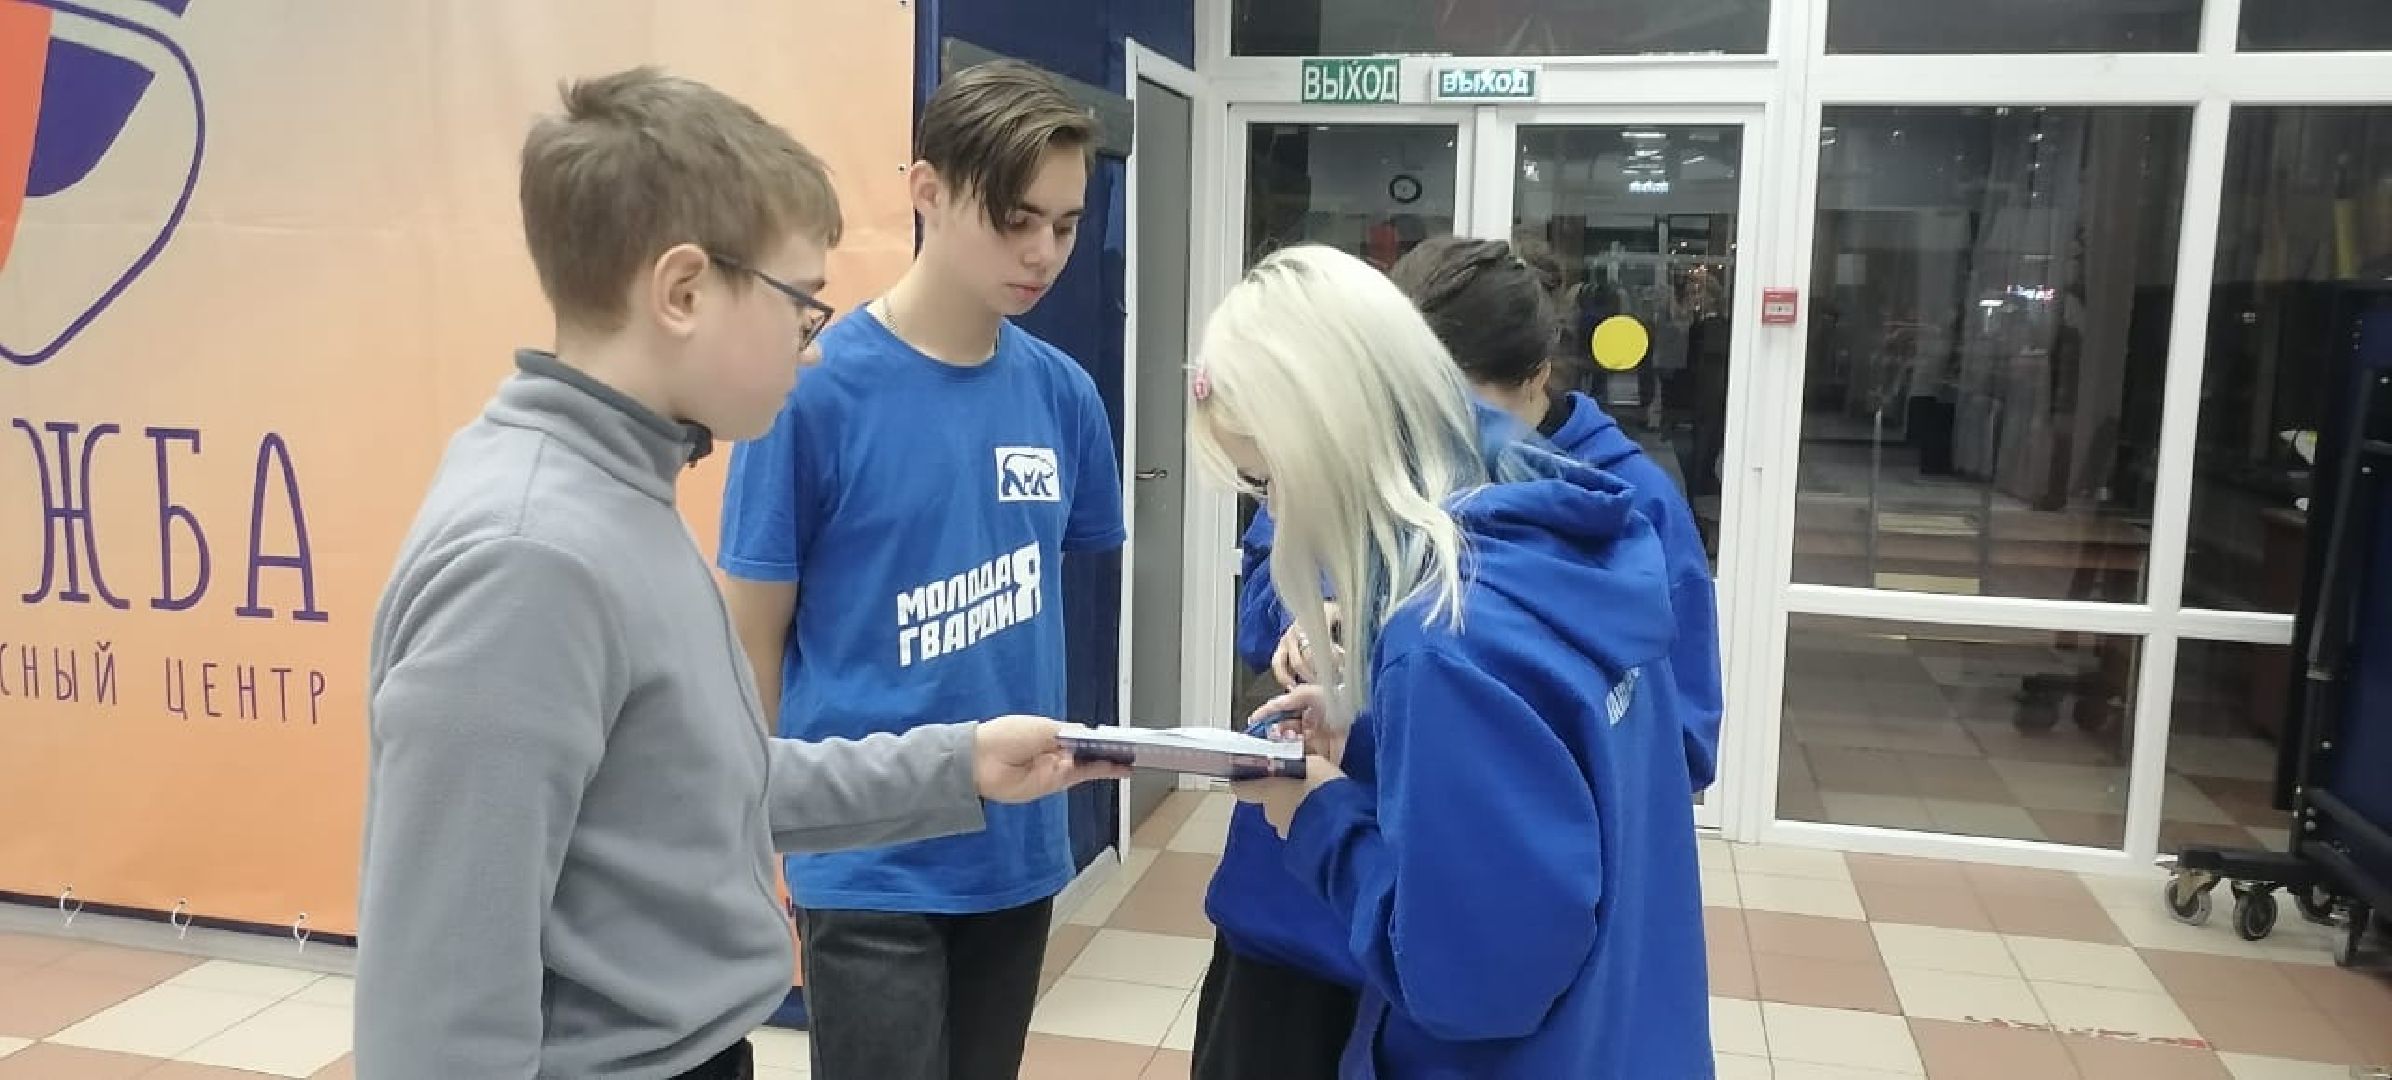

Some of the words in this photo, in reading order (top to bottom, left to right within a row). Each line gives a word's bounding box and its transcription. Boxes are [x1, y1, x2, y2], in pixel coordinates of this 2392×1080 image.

[1305, 64, 1398, 101] ВЫХОД
[1443, 69, 1529, 94] ВЫХОД
[12, 418, 329, 622] ЖБА
[0, 641, 117, 705] СНЫЙ
[166, 657, 326, 725] ЦЕНТР
